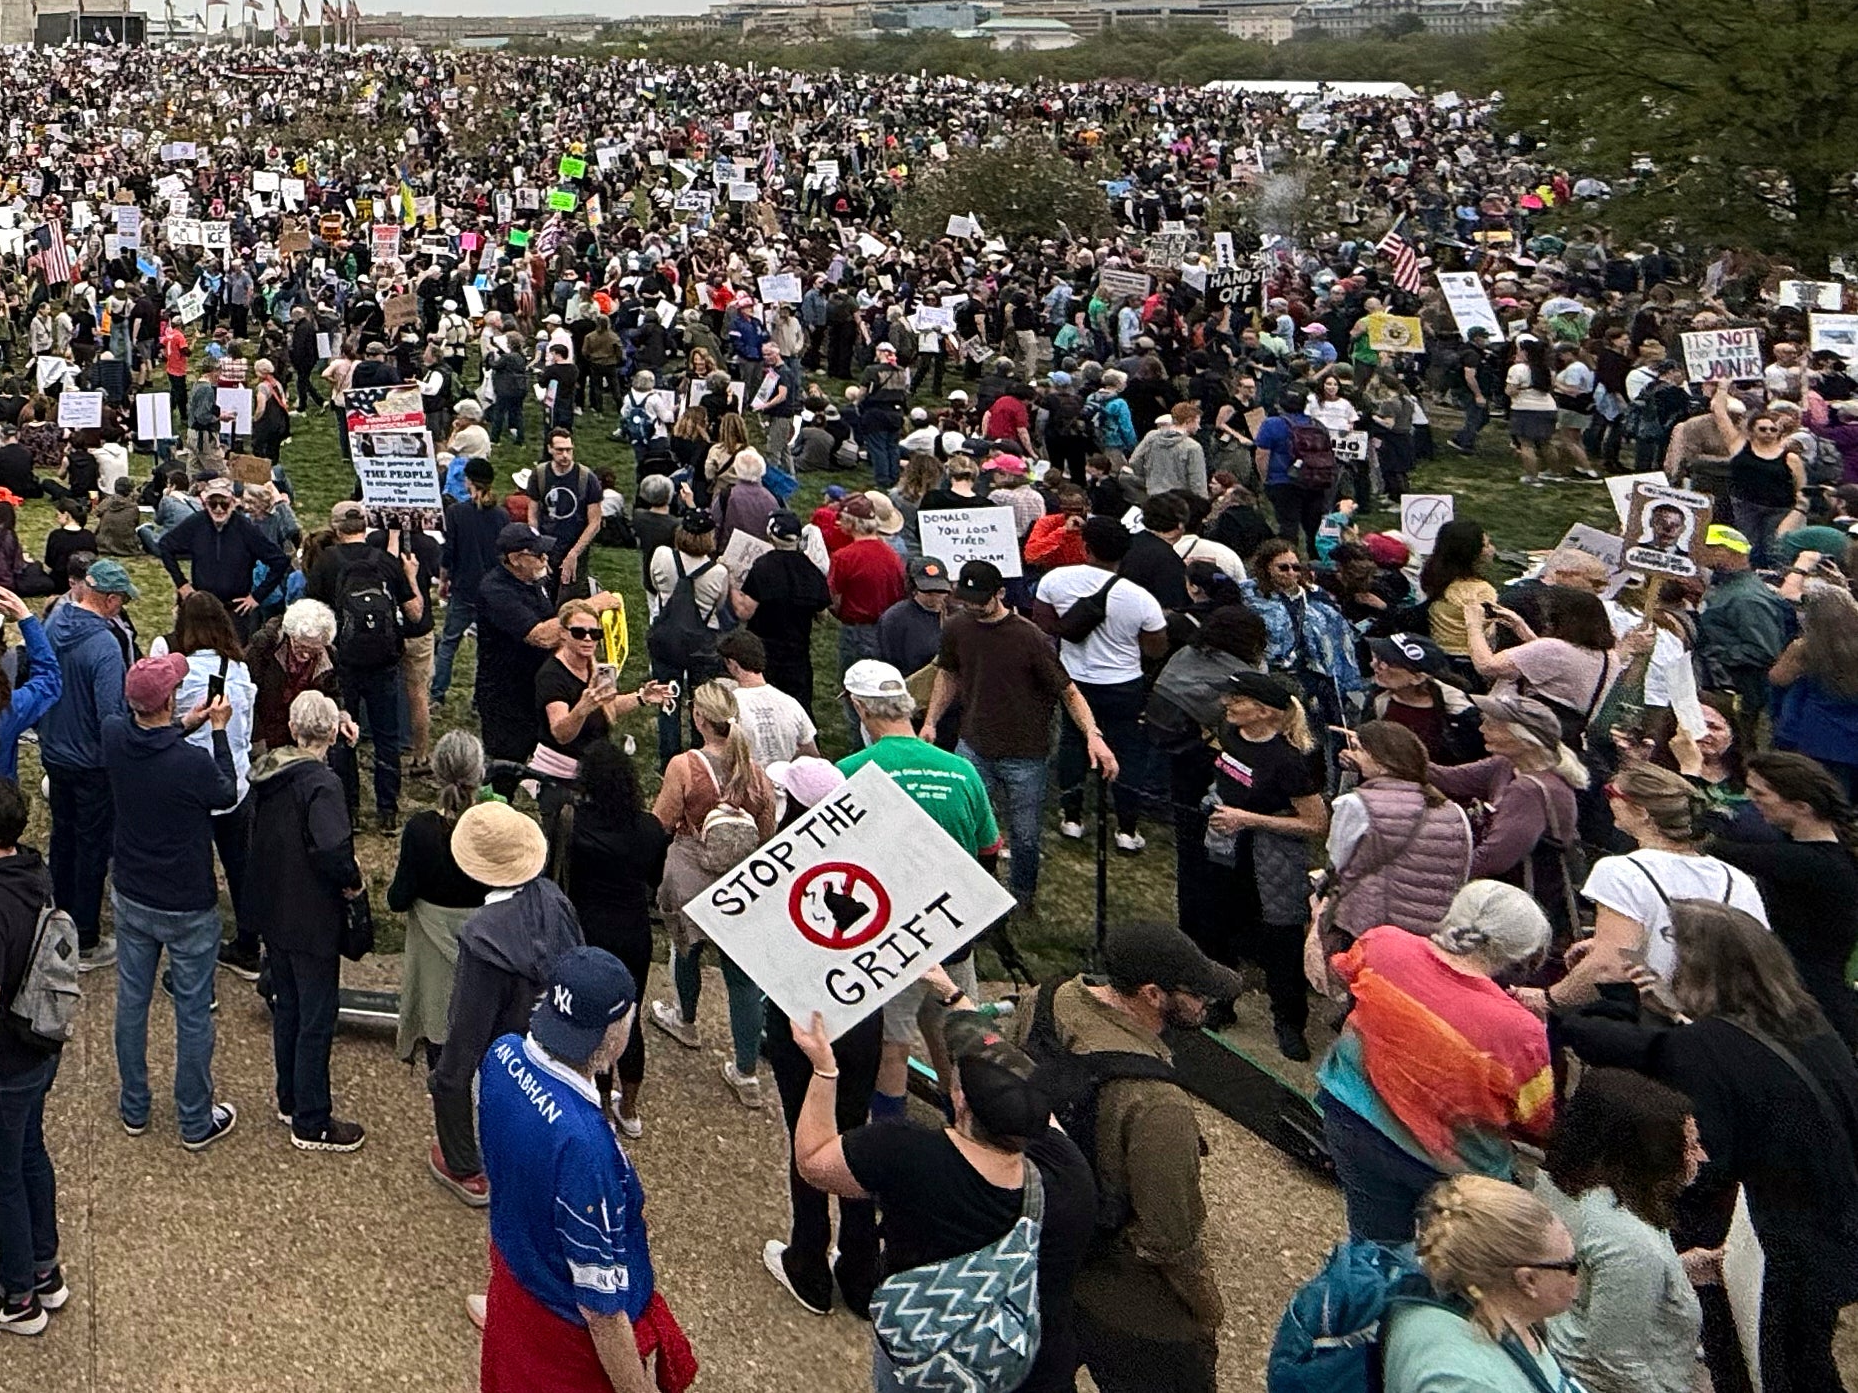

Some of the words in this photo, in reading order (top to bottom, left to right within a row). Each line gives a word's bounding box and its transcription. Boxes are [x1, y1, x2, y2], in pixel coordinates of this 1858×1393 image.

[207, 232, 226, 244] ICE
[1210, 270, 1261, 288] HANDS
[1219, 285, 1252, 303] OFF
[1717, 329, 1753, 348] NOT
[1716, 346, 1755, 357] LATE
[1743, 357, 1760, 376] US
[387, 460, 414, 468] power
[364, 470, 388, 479] THE
[389, 470, 434, 479] PEOPLE
[375, 481, 412, 489] stronger
[369, 495, 396, 503] people
[398, 495, 407, 503] in
[409, 496, 436, 504] power
[938, 525, 960, 536] YOU
[967, 524, 999, 534] LOOK
[953, 554, 977, 562] OLD
[711, 841, 796, 916] STOP
[794, 793, 868, 849] THE
[825, 892, 965, 1005] GRIFT
[554, 984, 572, 1016] NY
[495, 1043, 515, 1065] AN
[508, 1058, 563, 1124] CABHÁN
